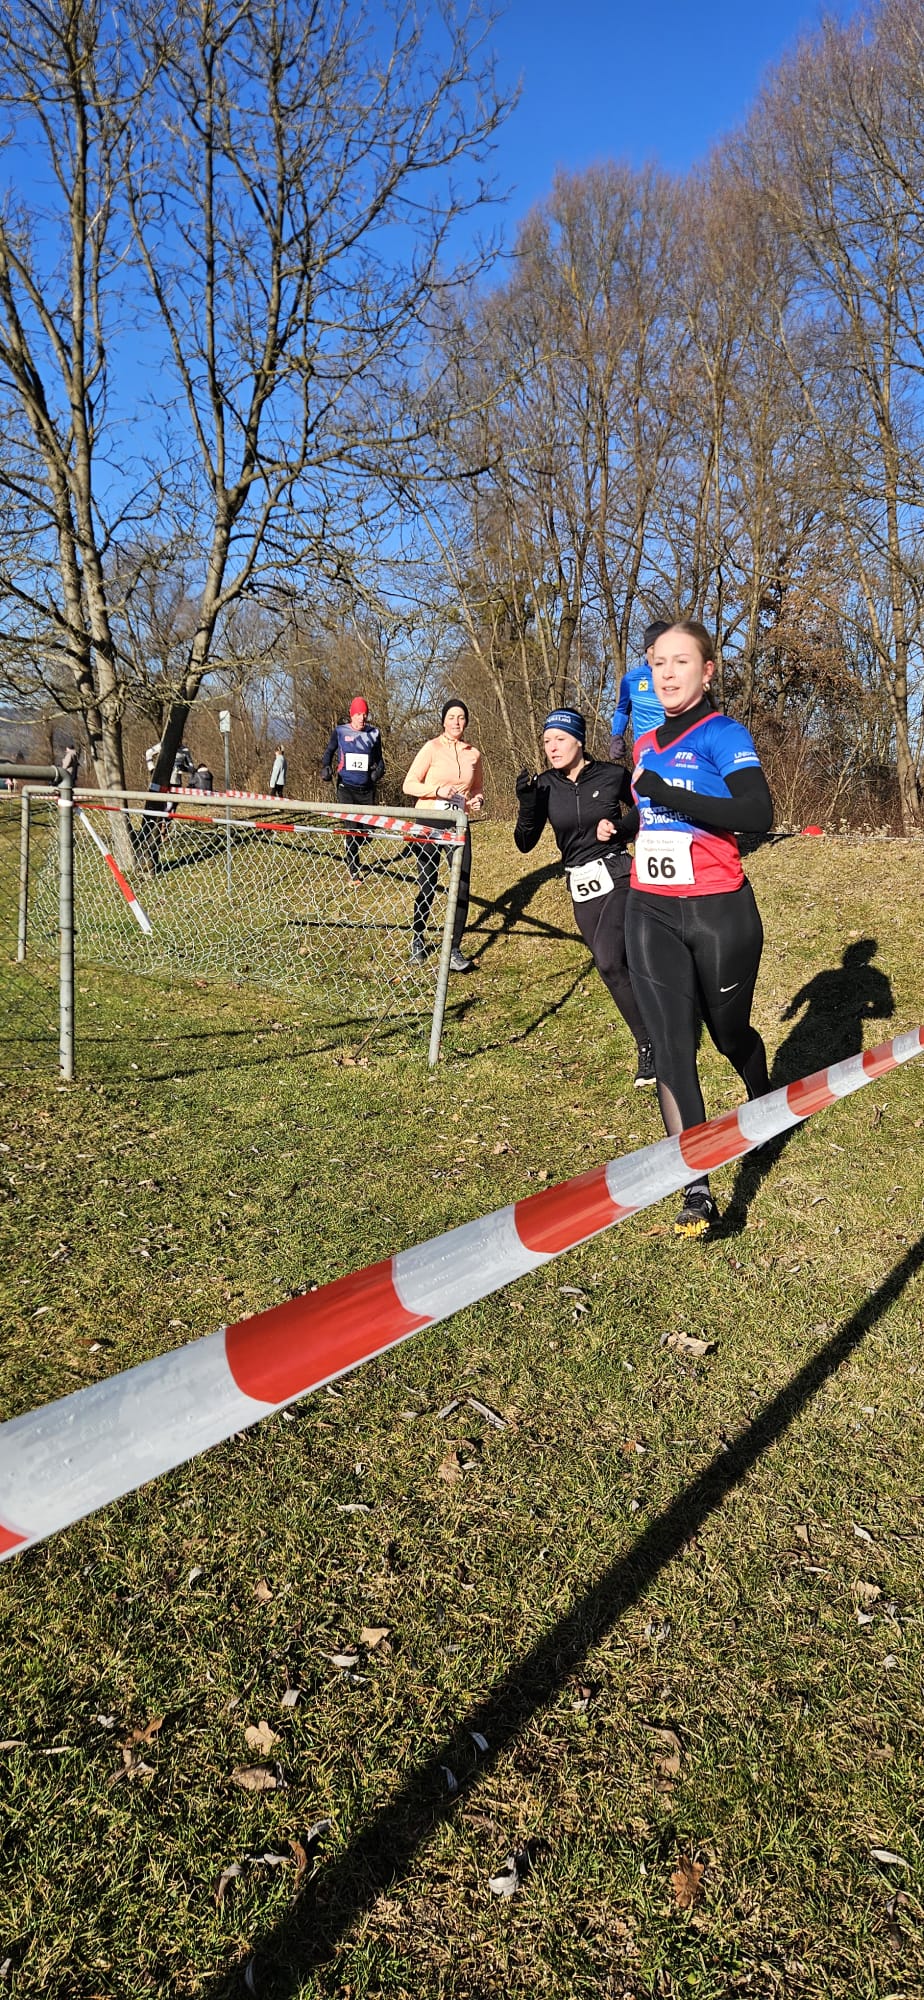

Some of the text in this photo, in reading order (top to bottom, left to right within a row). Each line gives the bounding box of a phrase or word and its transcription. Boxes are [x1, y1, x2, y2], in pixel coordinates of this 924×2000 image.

[352, 761, 363, 769] 42
[647, 856, 676, 879] 66
[577, 879, 602, 897] 50
